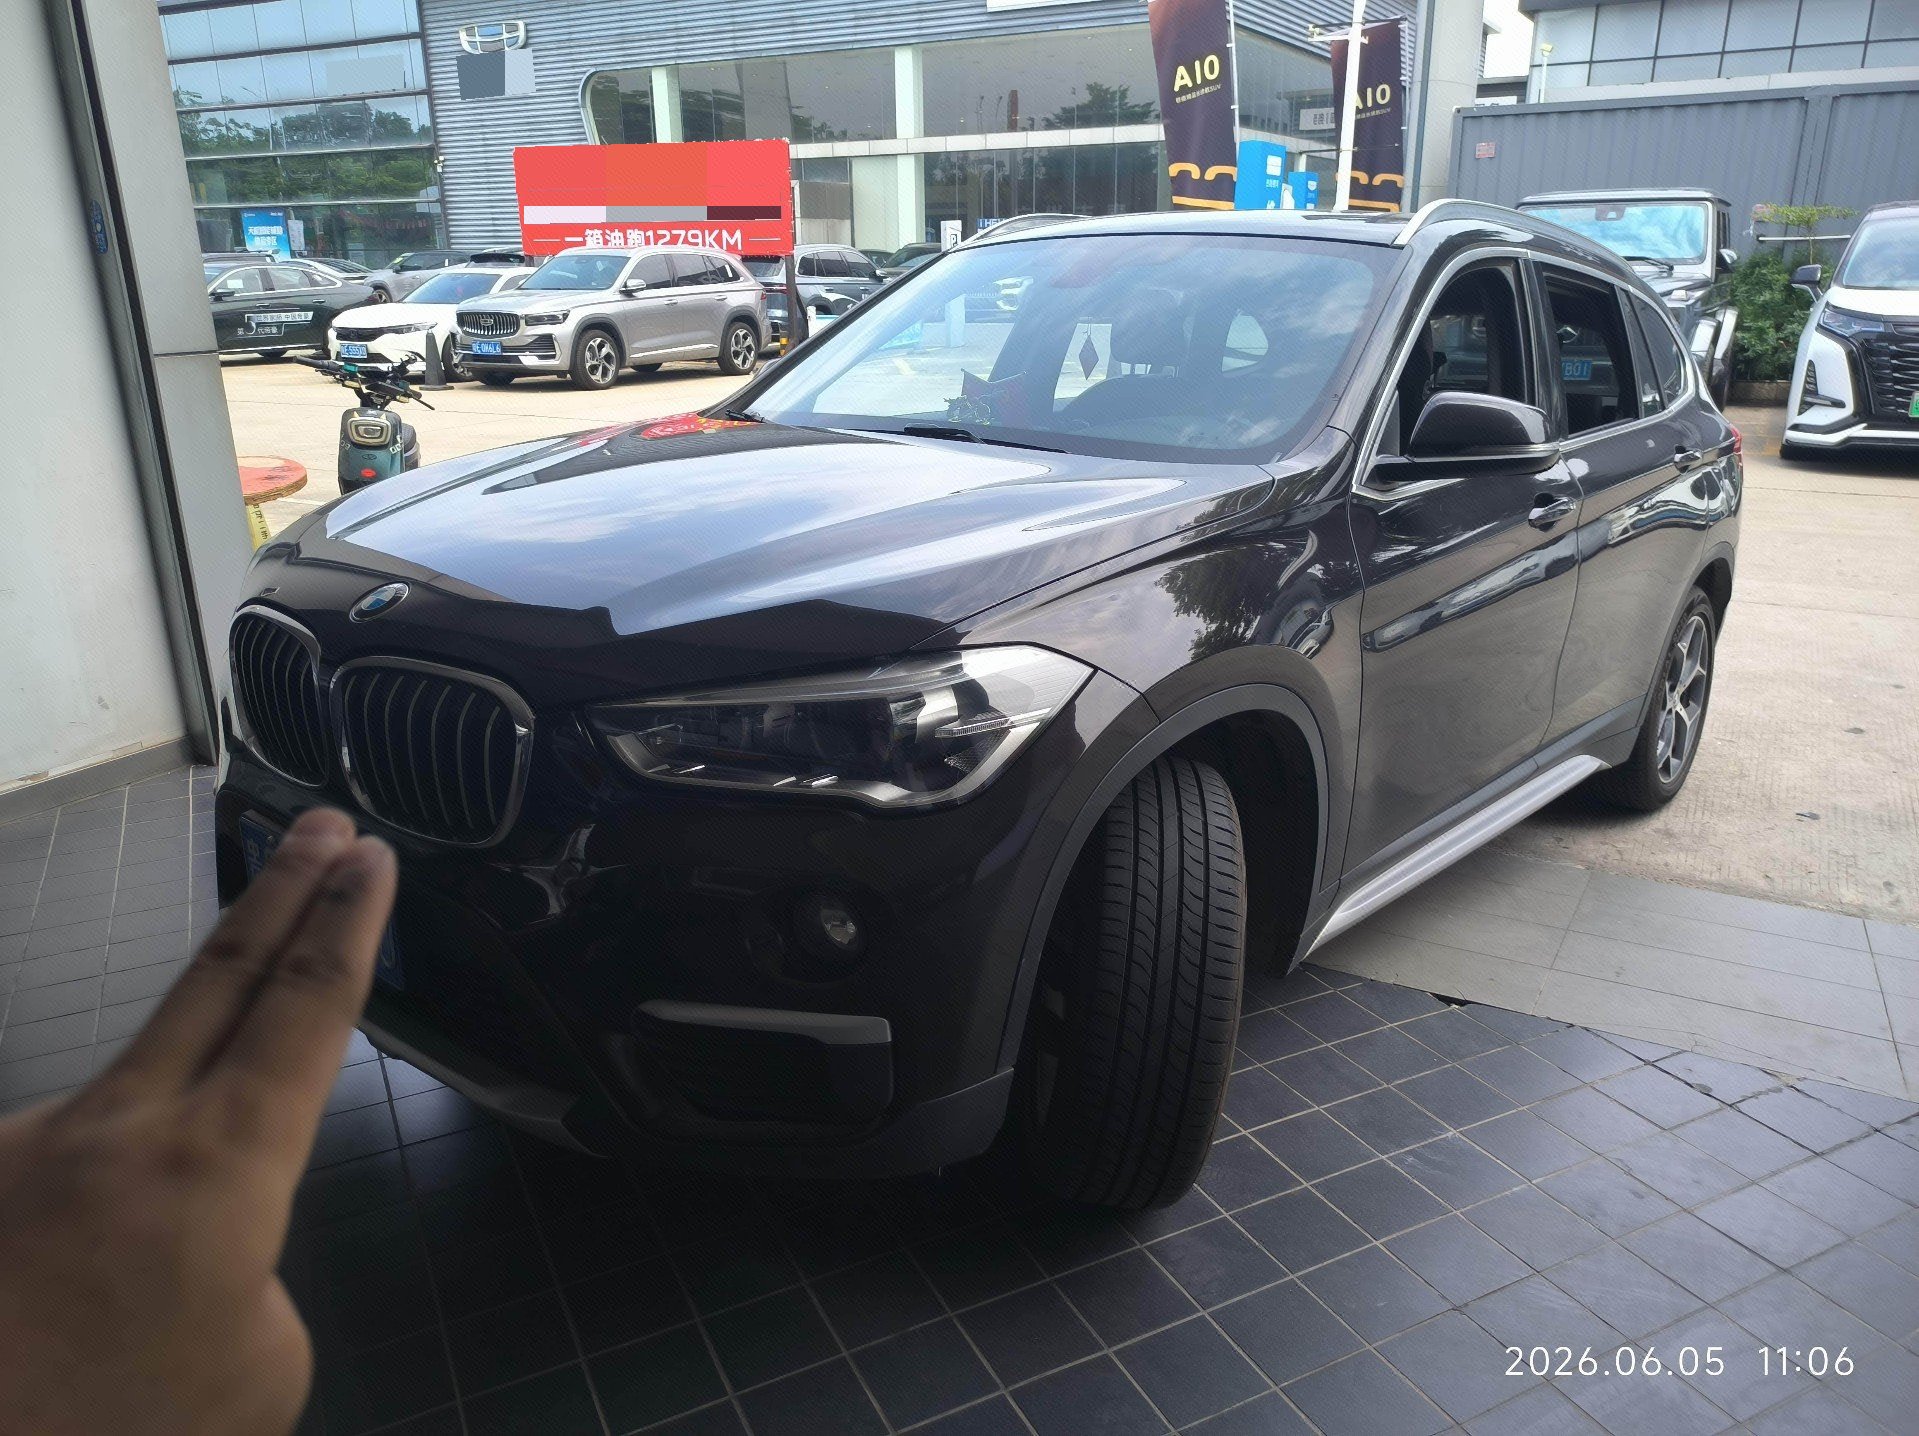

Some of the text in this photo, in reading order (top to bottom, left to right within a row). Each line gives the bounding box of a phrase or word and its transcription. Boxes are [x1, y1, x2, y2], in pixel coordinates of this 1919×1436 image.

[1173, 54, 1220, 92] A10
[564, 228, 742, 250] 一箱油跑1279KM
